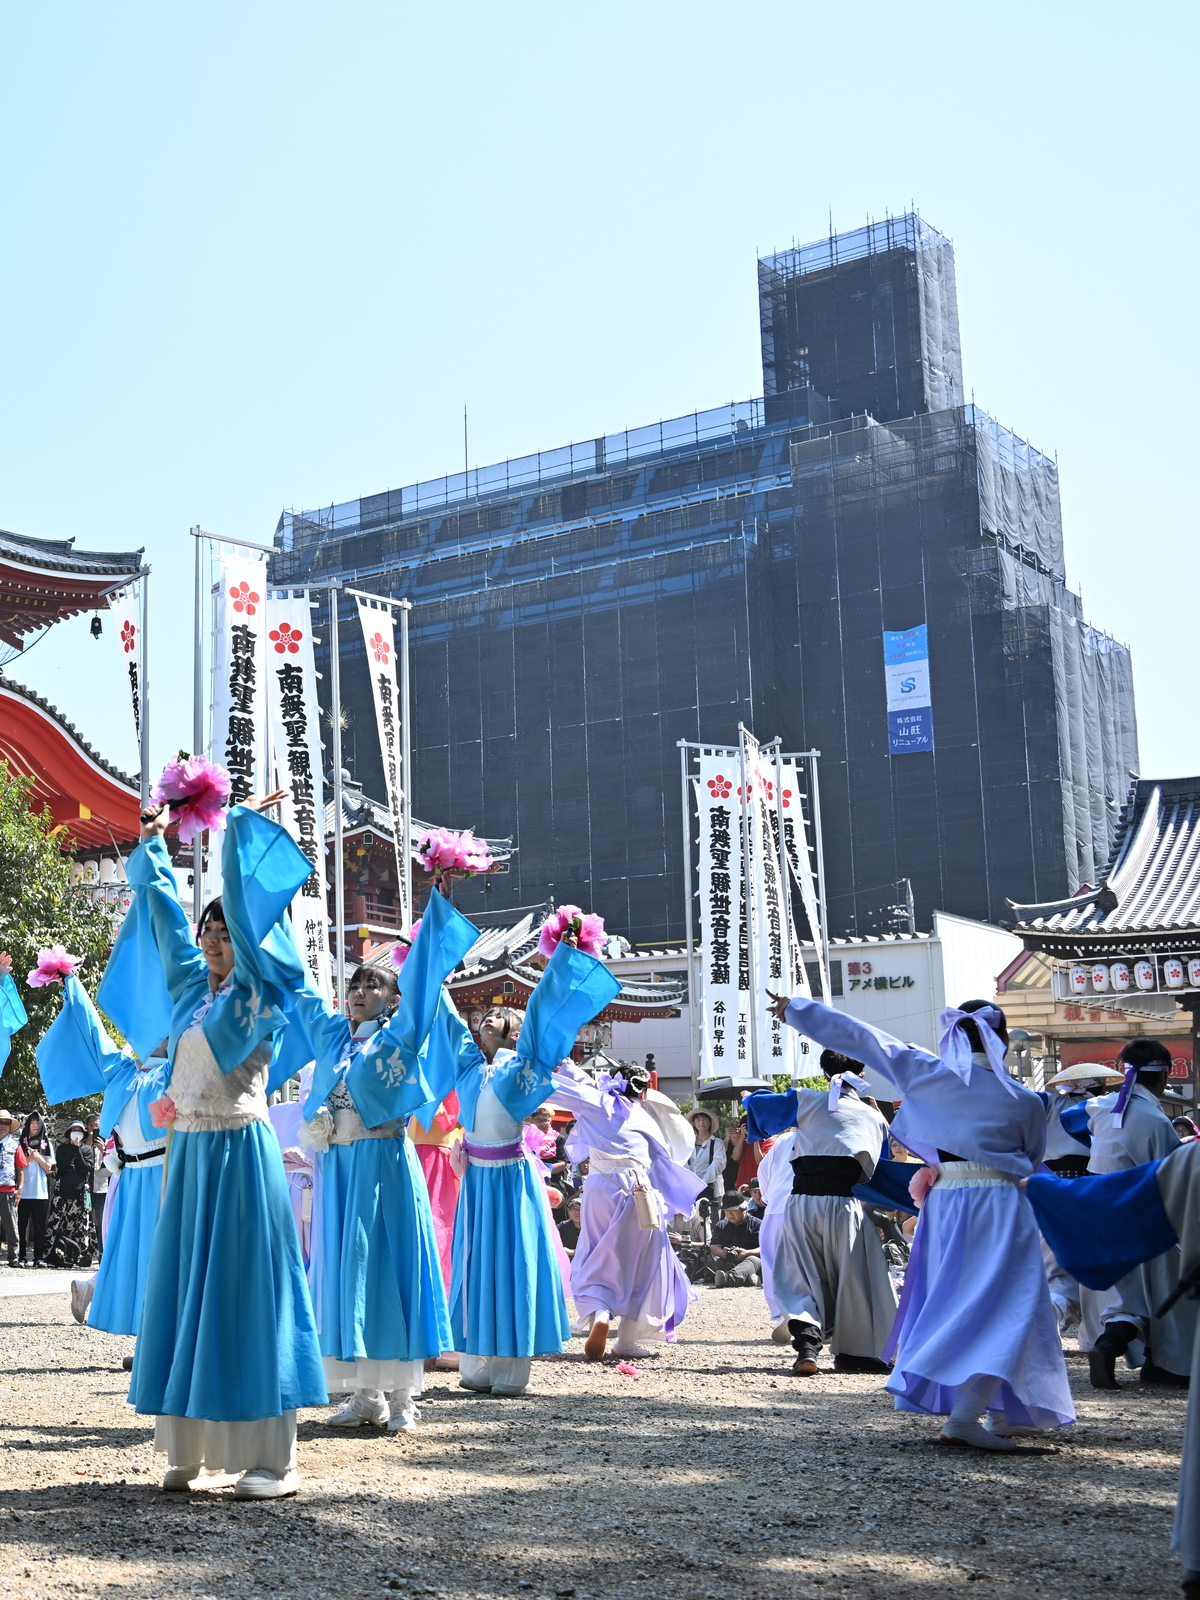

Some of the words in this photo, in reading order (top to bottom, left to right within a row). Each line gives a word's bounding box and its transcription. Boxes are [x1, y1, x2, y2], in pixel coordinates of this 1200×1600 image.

[897, 715, 922, 724] 株式会社
[899, 725, 921, 736] 山旺
[893, 736, 929, 747] リニューアル
[847, 962, 872, 975] 第3
[848, 976, 915, 991] アメ横ビル
